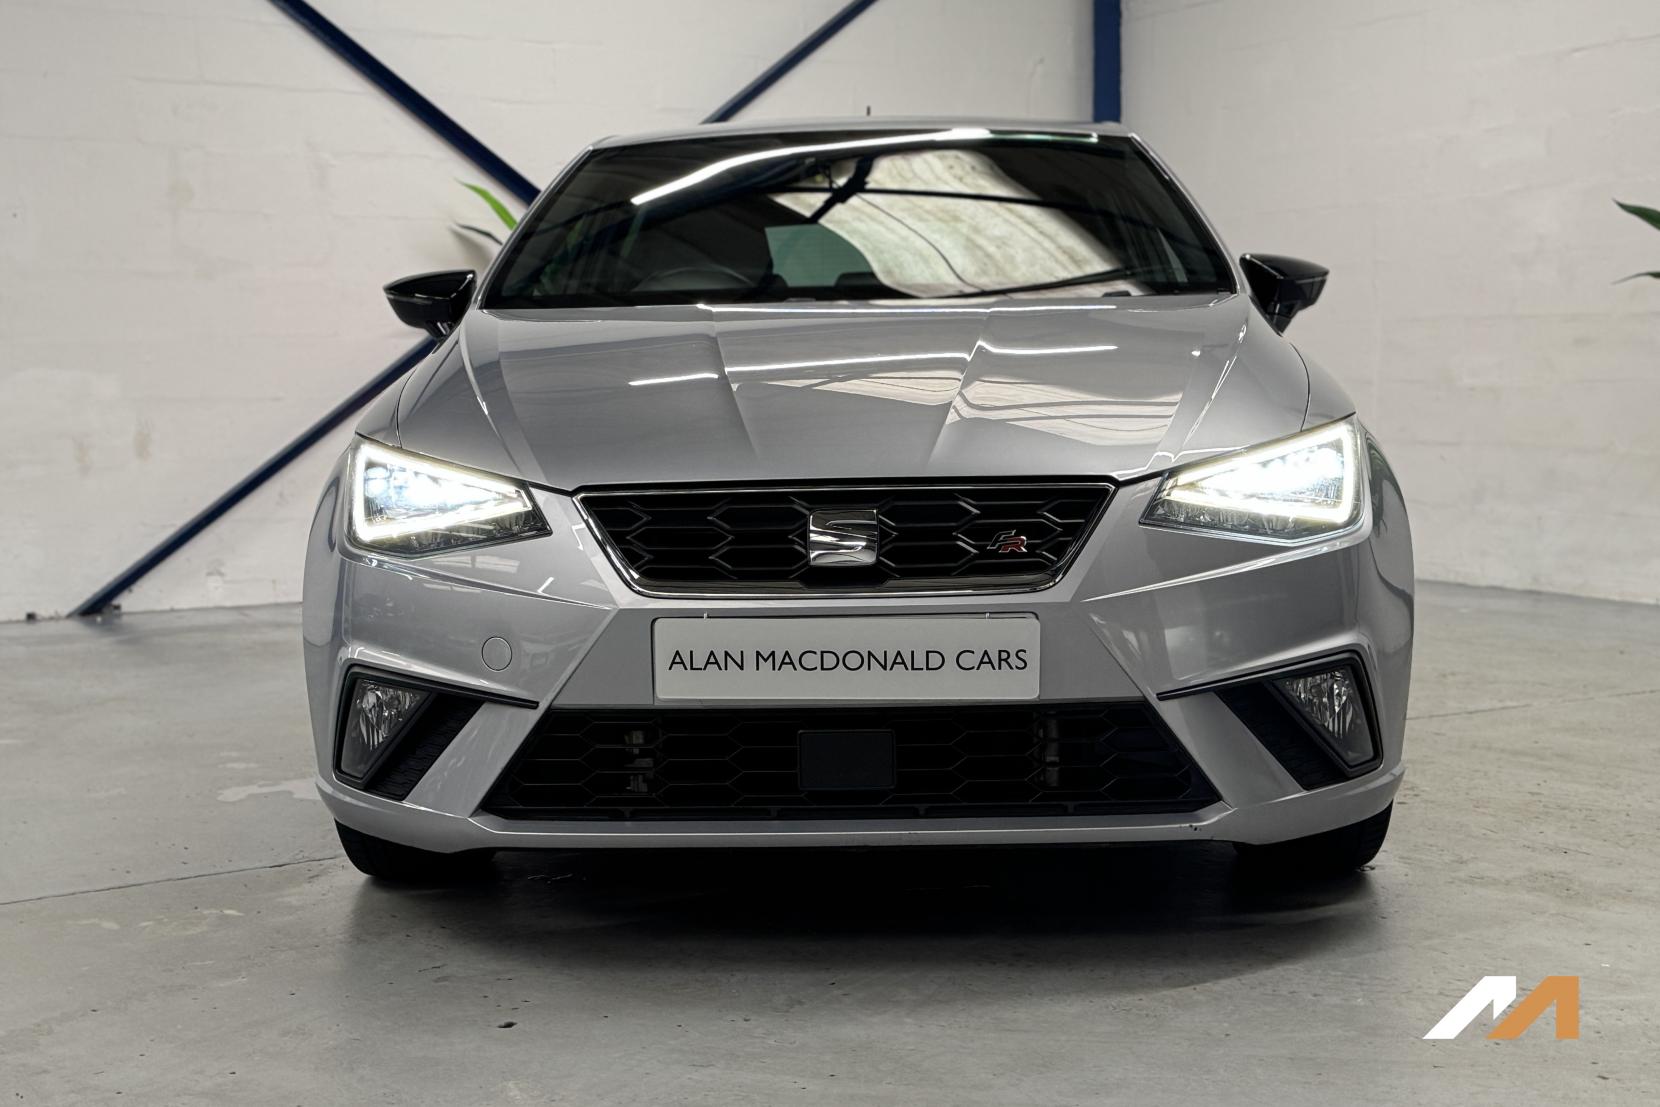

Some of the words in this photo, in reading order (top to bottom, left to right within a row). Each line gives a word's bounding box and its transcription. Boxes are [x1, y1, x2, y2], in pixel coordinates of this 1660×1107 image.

[668, 649, 745, 672] ALAN
[755, 649, 946, 672] MACDONALD
[955, 648, 1028, 671] CARS
